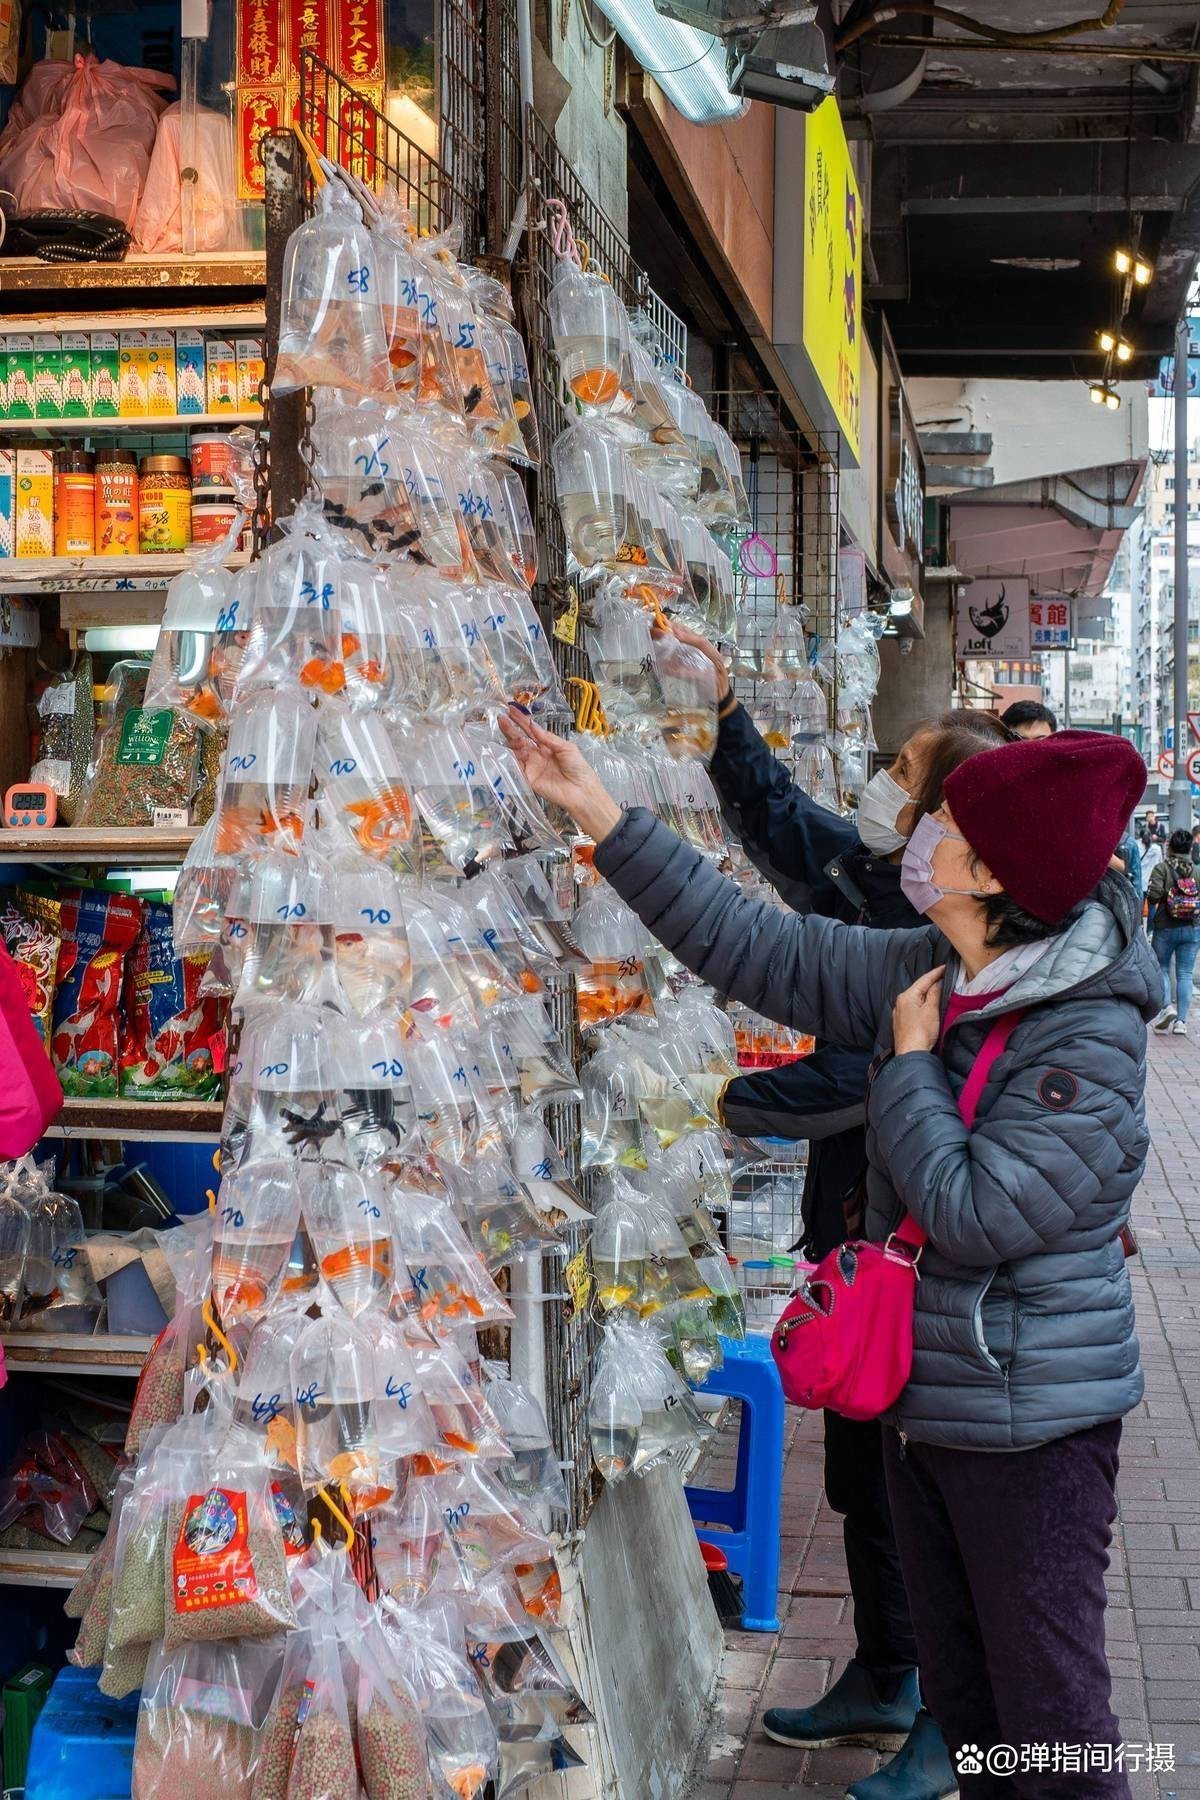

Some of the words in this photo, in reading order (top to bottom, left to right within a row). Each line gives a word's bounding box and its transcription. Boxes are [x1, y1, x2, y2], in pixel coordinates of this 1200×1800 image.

[346, 0, 373, 73] 工大吉
[347, 266, 370, 293] 58
[617, 955, 639, 981] 38
[663, 1395, 679, 1412] 12
